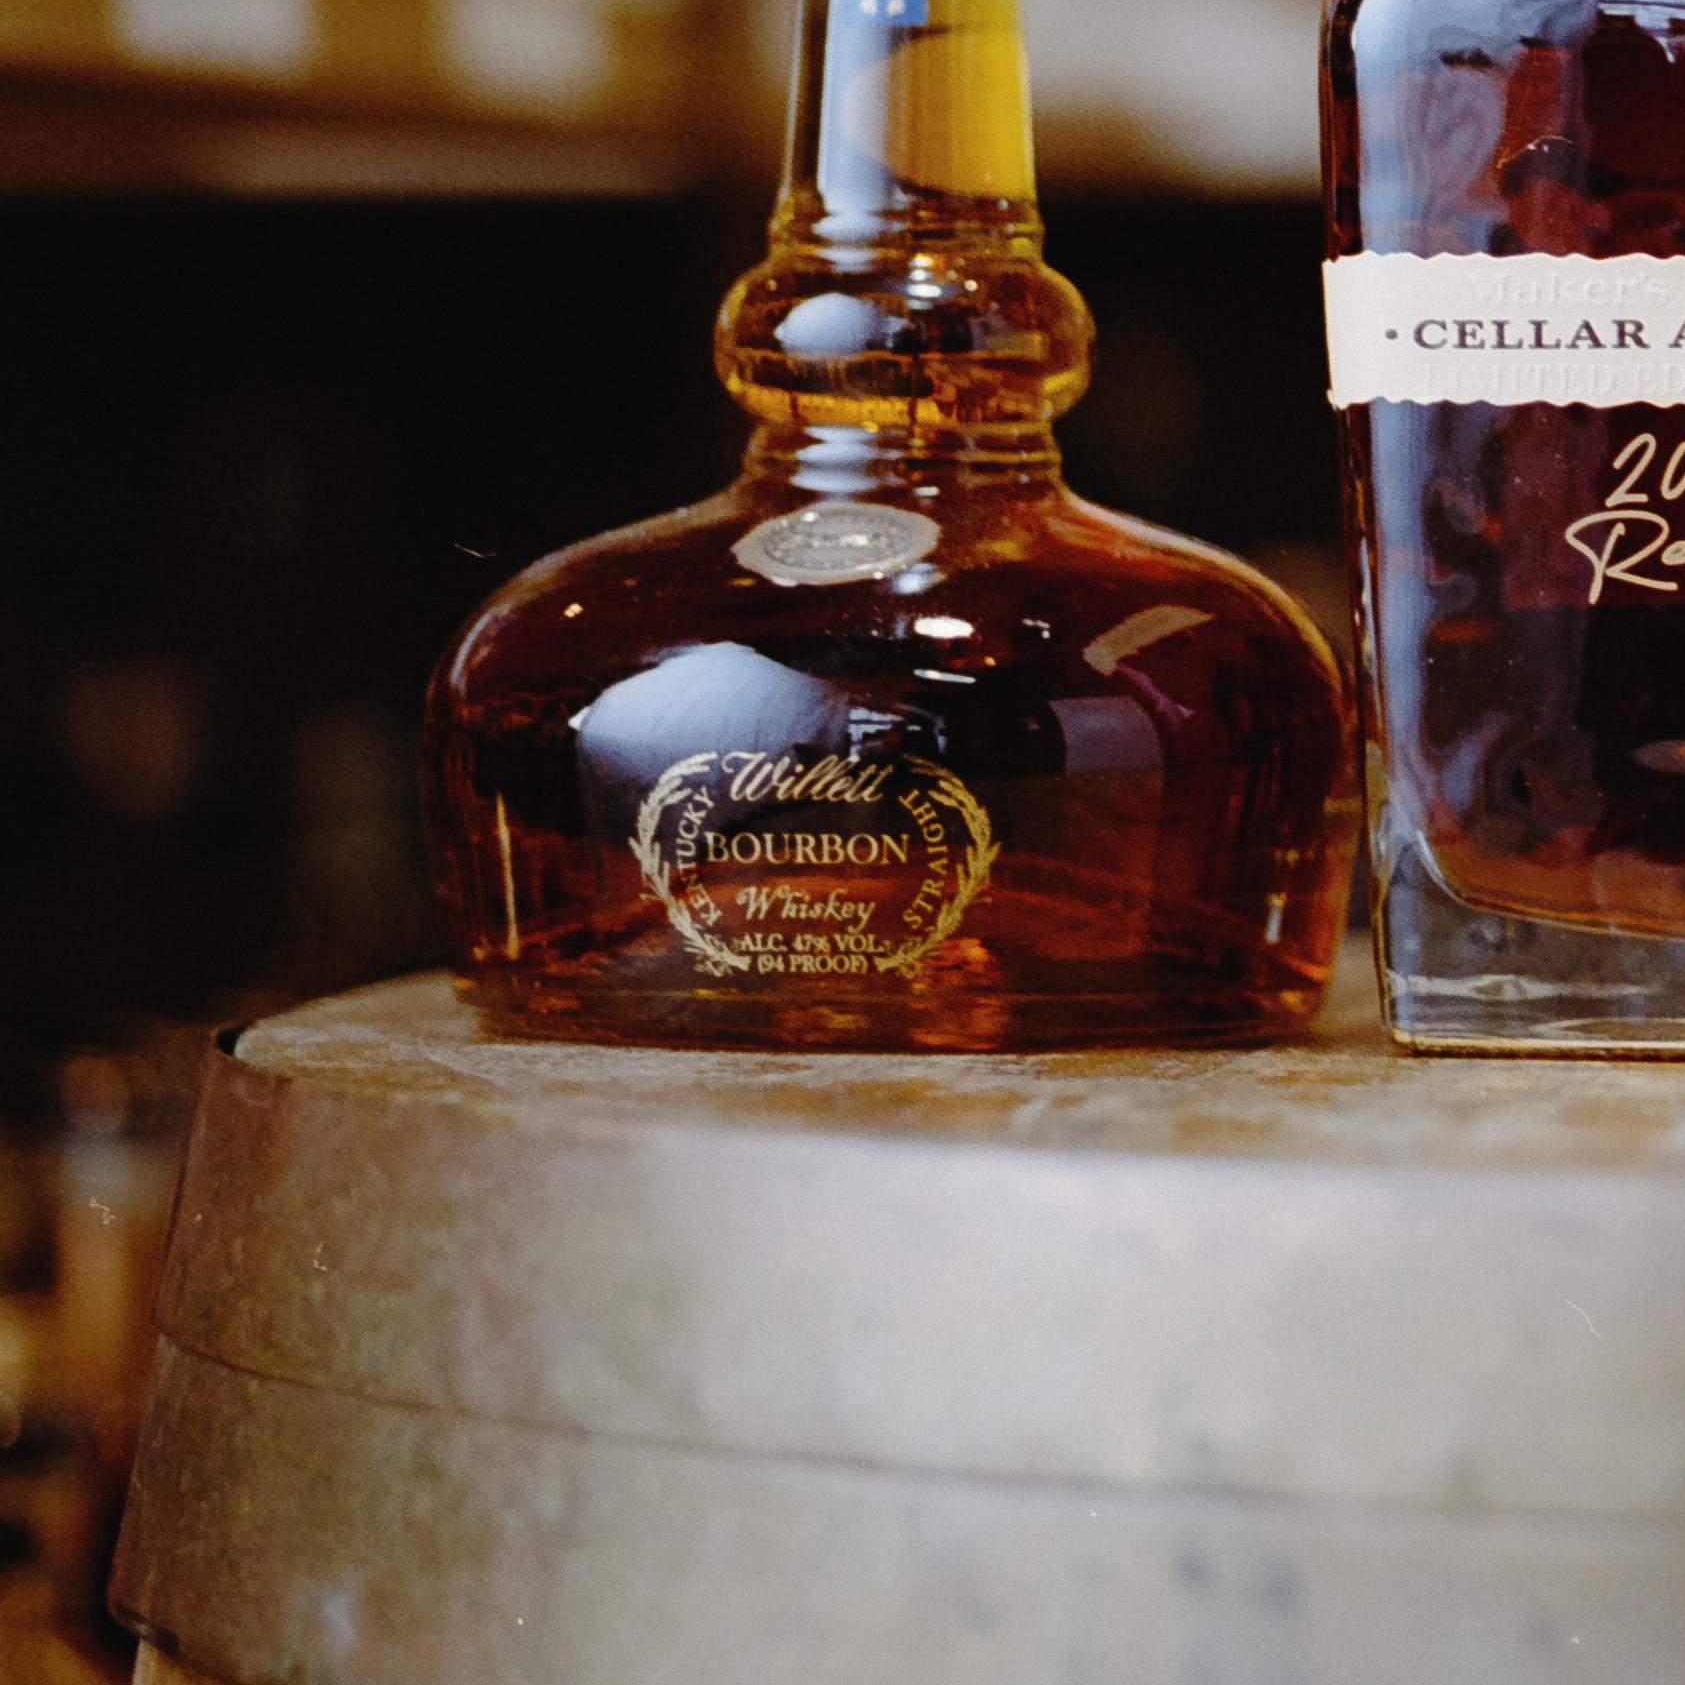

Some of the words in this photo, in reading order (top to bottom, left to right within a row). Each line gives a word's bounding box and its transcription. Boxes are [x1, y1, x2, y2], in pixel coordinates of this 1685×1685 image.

[1412, 318, 1651, 350] CELLAR
[721, 749, 895, 804] Willett
[675, 785, 723, 927] KENTUCKY
[703, 831, 911, 866] BOURBON
[898, 788, 949, 931] STRAIGHT
[736, 883, 877, 935] Whiskey
[739, 933, 789, 953] ALC.
[757, 954, 785, 975] (94
[789, 954, 869, 975] PROOF)
